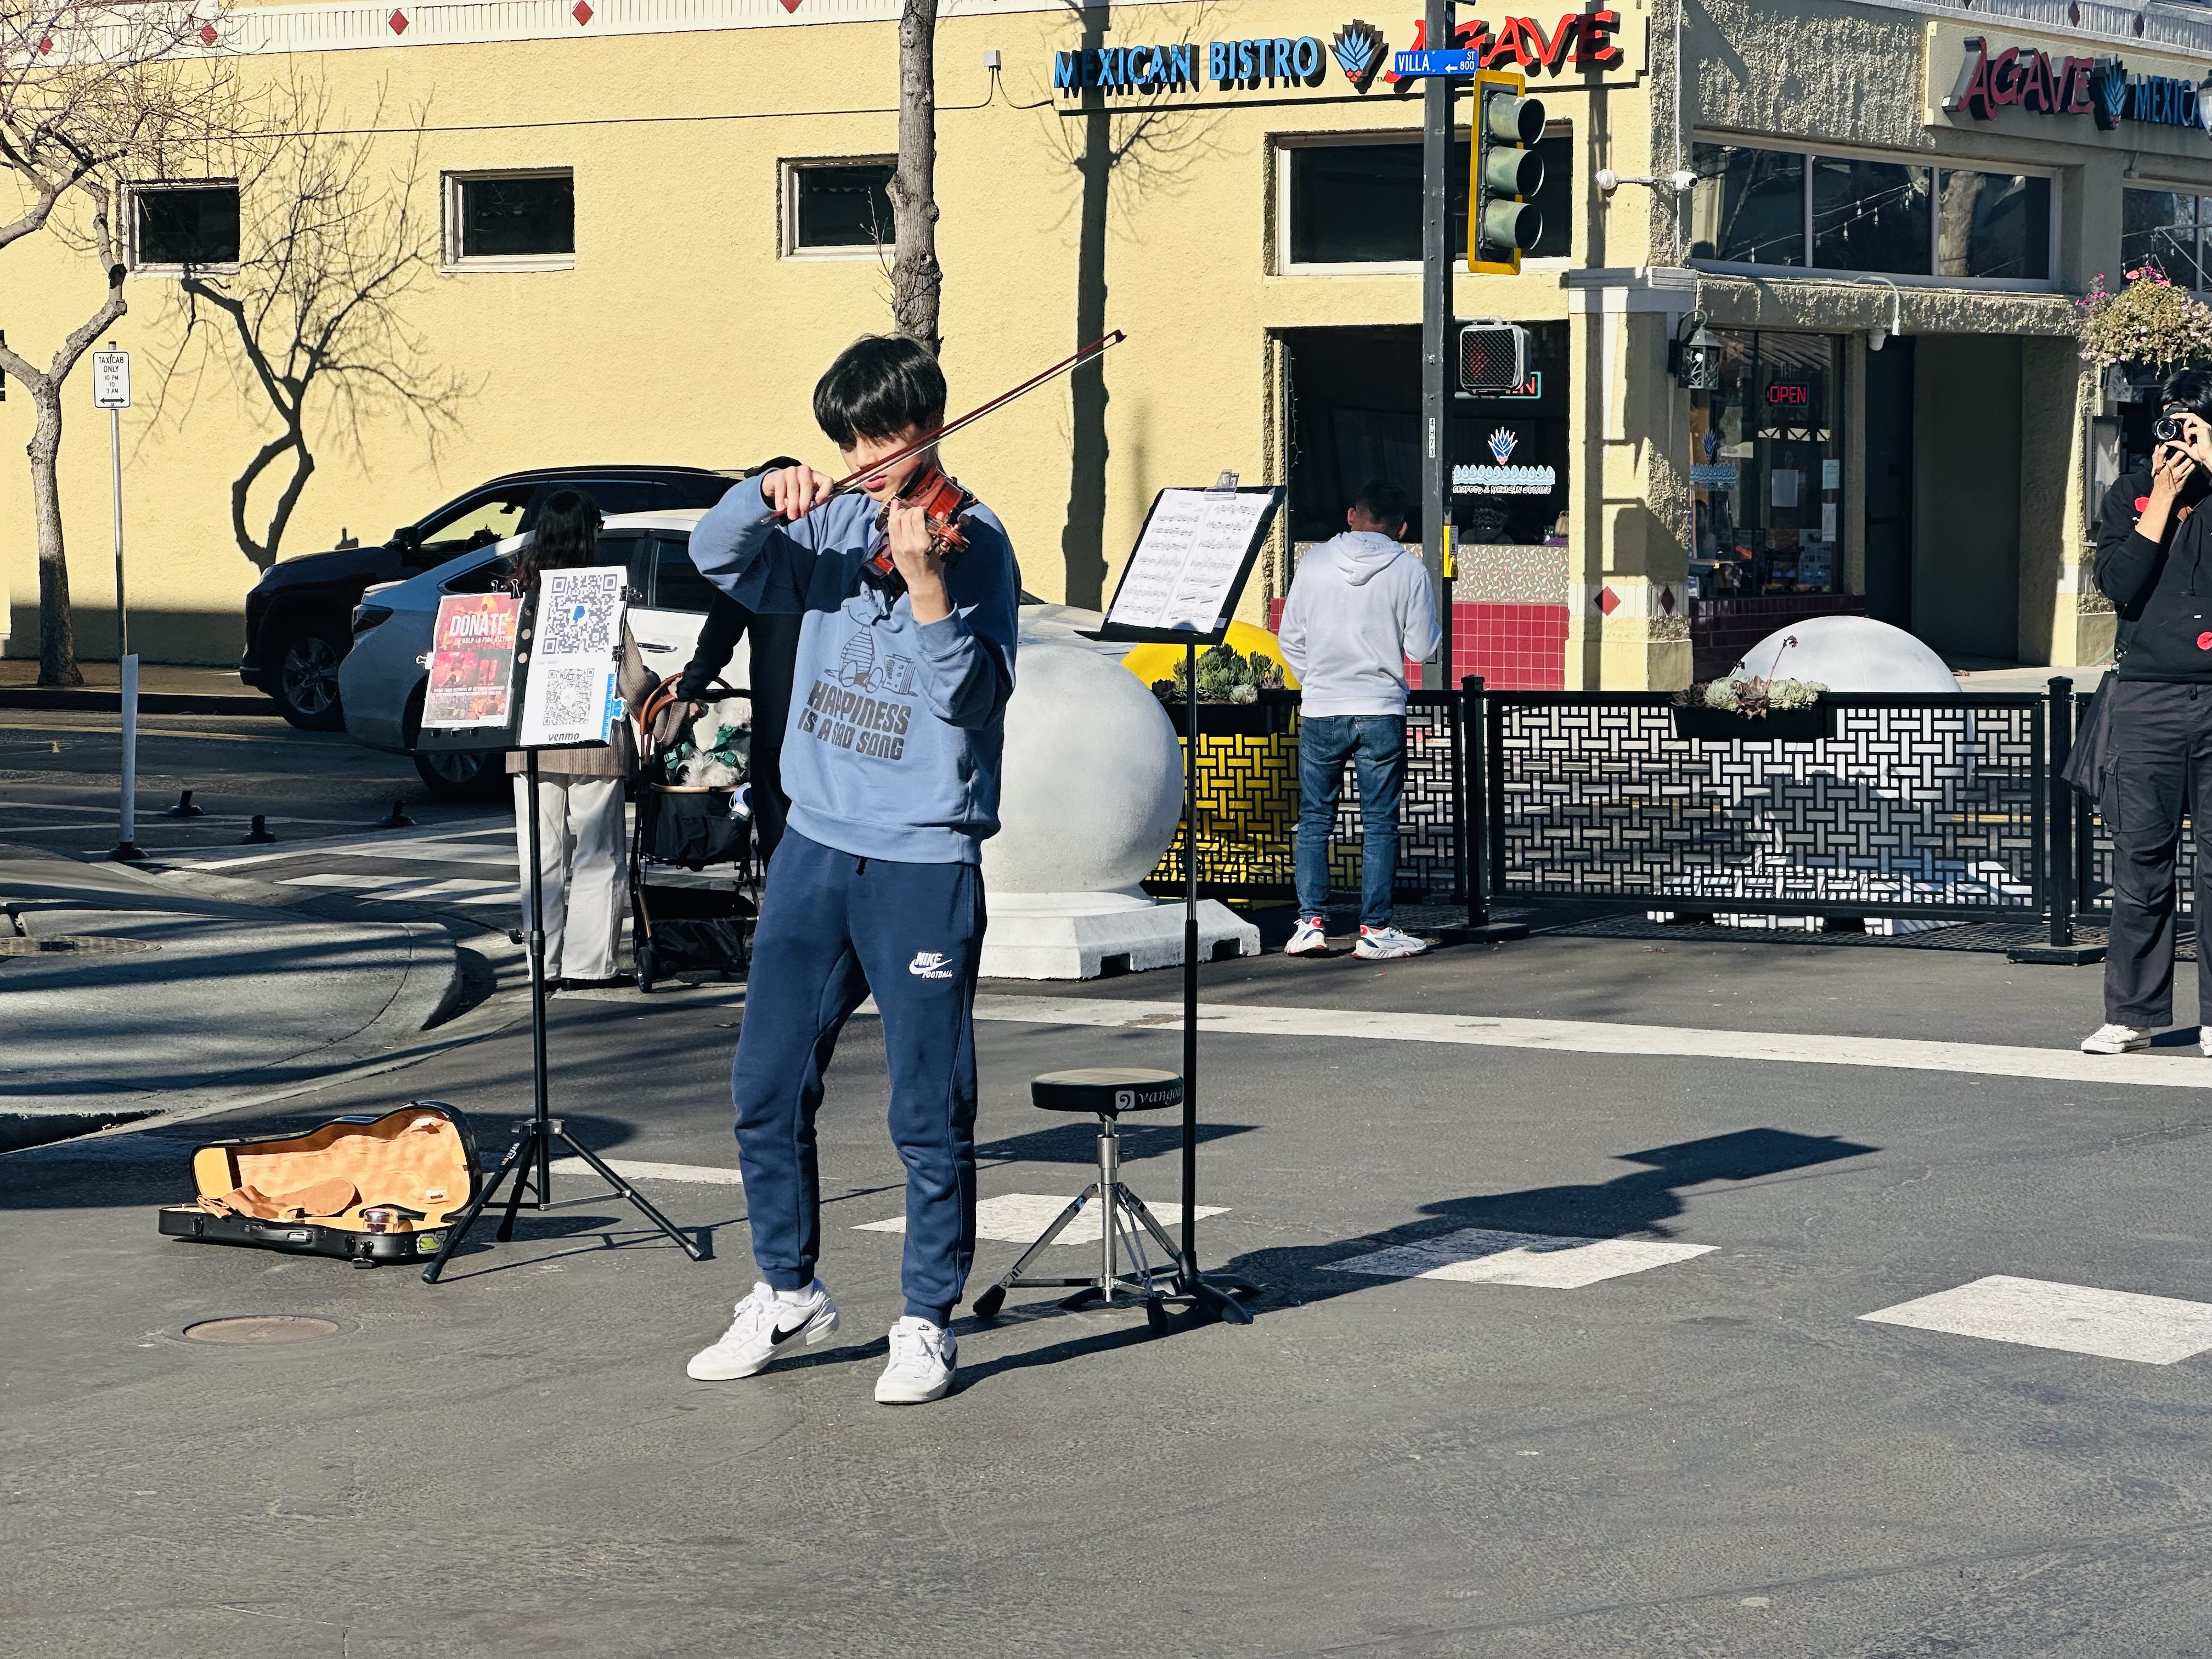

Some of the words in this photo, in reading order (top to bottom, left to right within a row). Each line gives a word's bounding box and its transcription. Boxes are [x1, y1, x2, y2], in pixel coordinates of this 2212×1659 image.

[1054, 43, 1192, 88] MEXICAN
[1210, 36, 1318, 81] BISTRO
[1398, 54, 1430, 72] VILLA
[1466, 51, 1475, 60] ST
[1460, 61, 1475, 70] 800
[1958, 36, 2095, 121] AGAVE
[1770, 386, 1807, 403] OPEN
[1452, 485, 1483, 494] SEAFOOD
[1491, 486, 1522, 494] MEXICAN
[449, 613, 507, 636] DONATE
[807, 680, 911, 735] HAPPINESS
[549, 733, 579, 741] venmo
[797, 708, 818, 733] IS
[817, 718, 833, 741] A
[831, 721, 855, 749] SAD
[856, 731, 904, 760] SONG
[915, 952, 943, 966] NIKE
[922, 970, 952, 978] FOOTBALL
